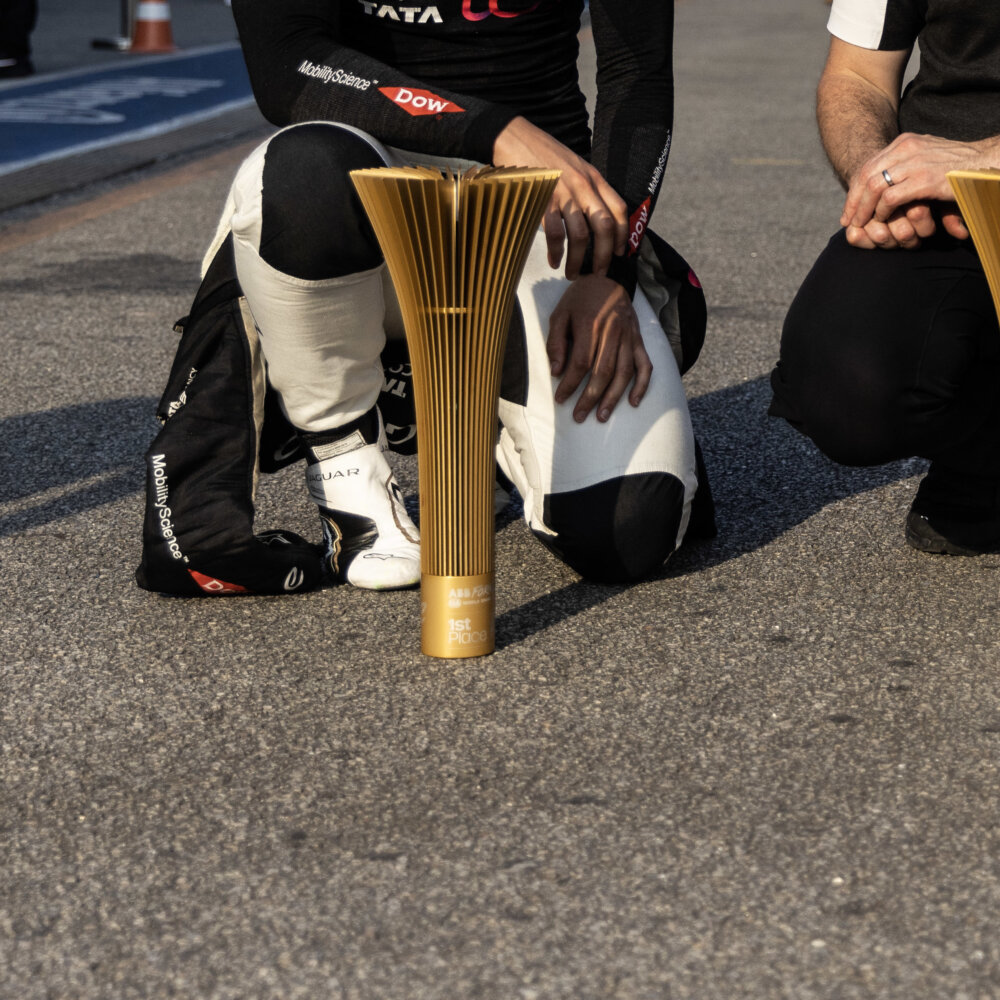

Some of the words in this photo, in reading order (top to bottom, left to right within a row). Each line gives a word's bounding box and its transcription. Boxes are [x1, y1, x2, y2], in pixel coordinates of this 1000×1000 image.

[357, 0, 444, 24] TATA
[447, 617, 472, 632] 1st
[447, 630, 488, 645] Place
